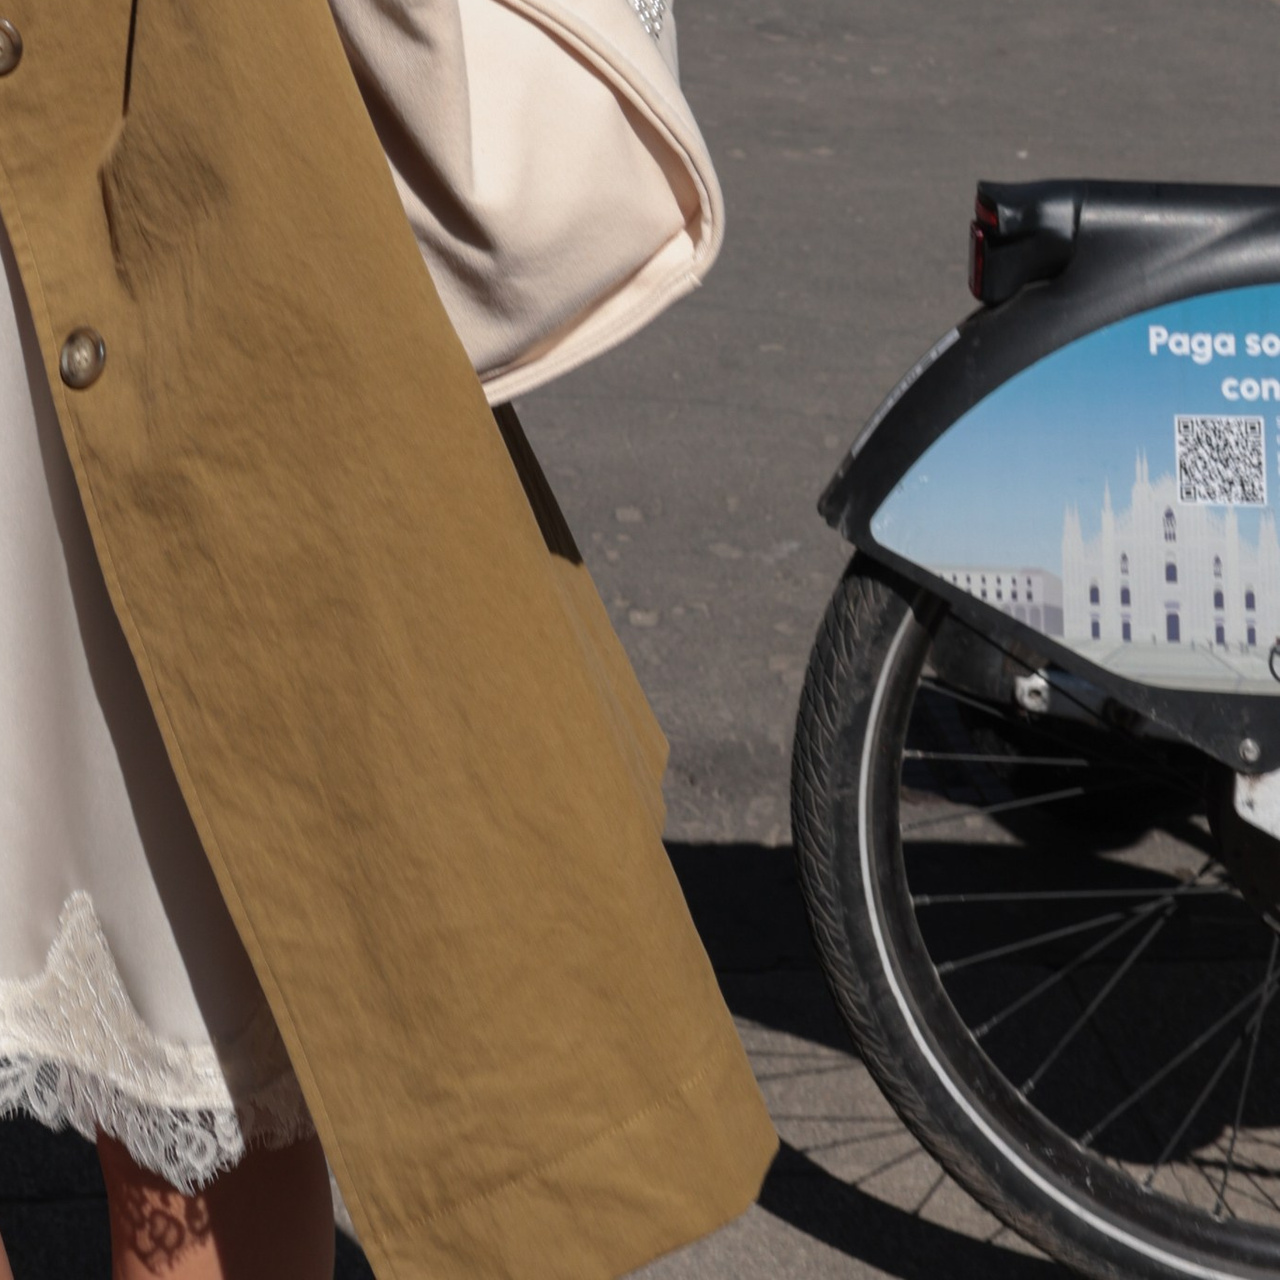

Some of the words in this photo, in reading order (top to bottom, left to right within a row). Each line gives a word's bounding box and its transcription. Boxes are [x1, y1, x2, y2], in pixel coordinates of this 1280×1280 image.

[1148, 325, 1236, 365] Paga
[1245, 332, 1280, 357] so
[1221, 377, 1280, 401] con
